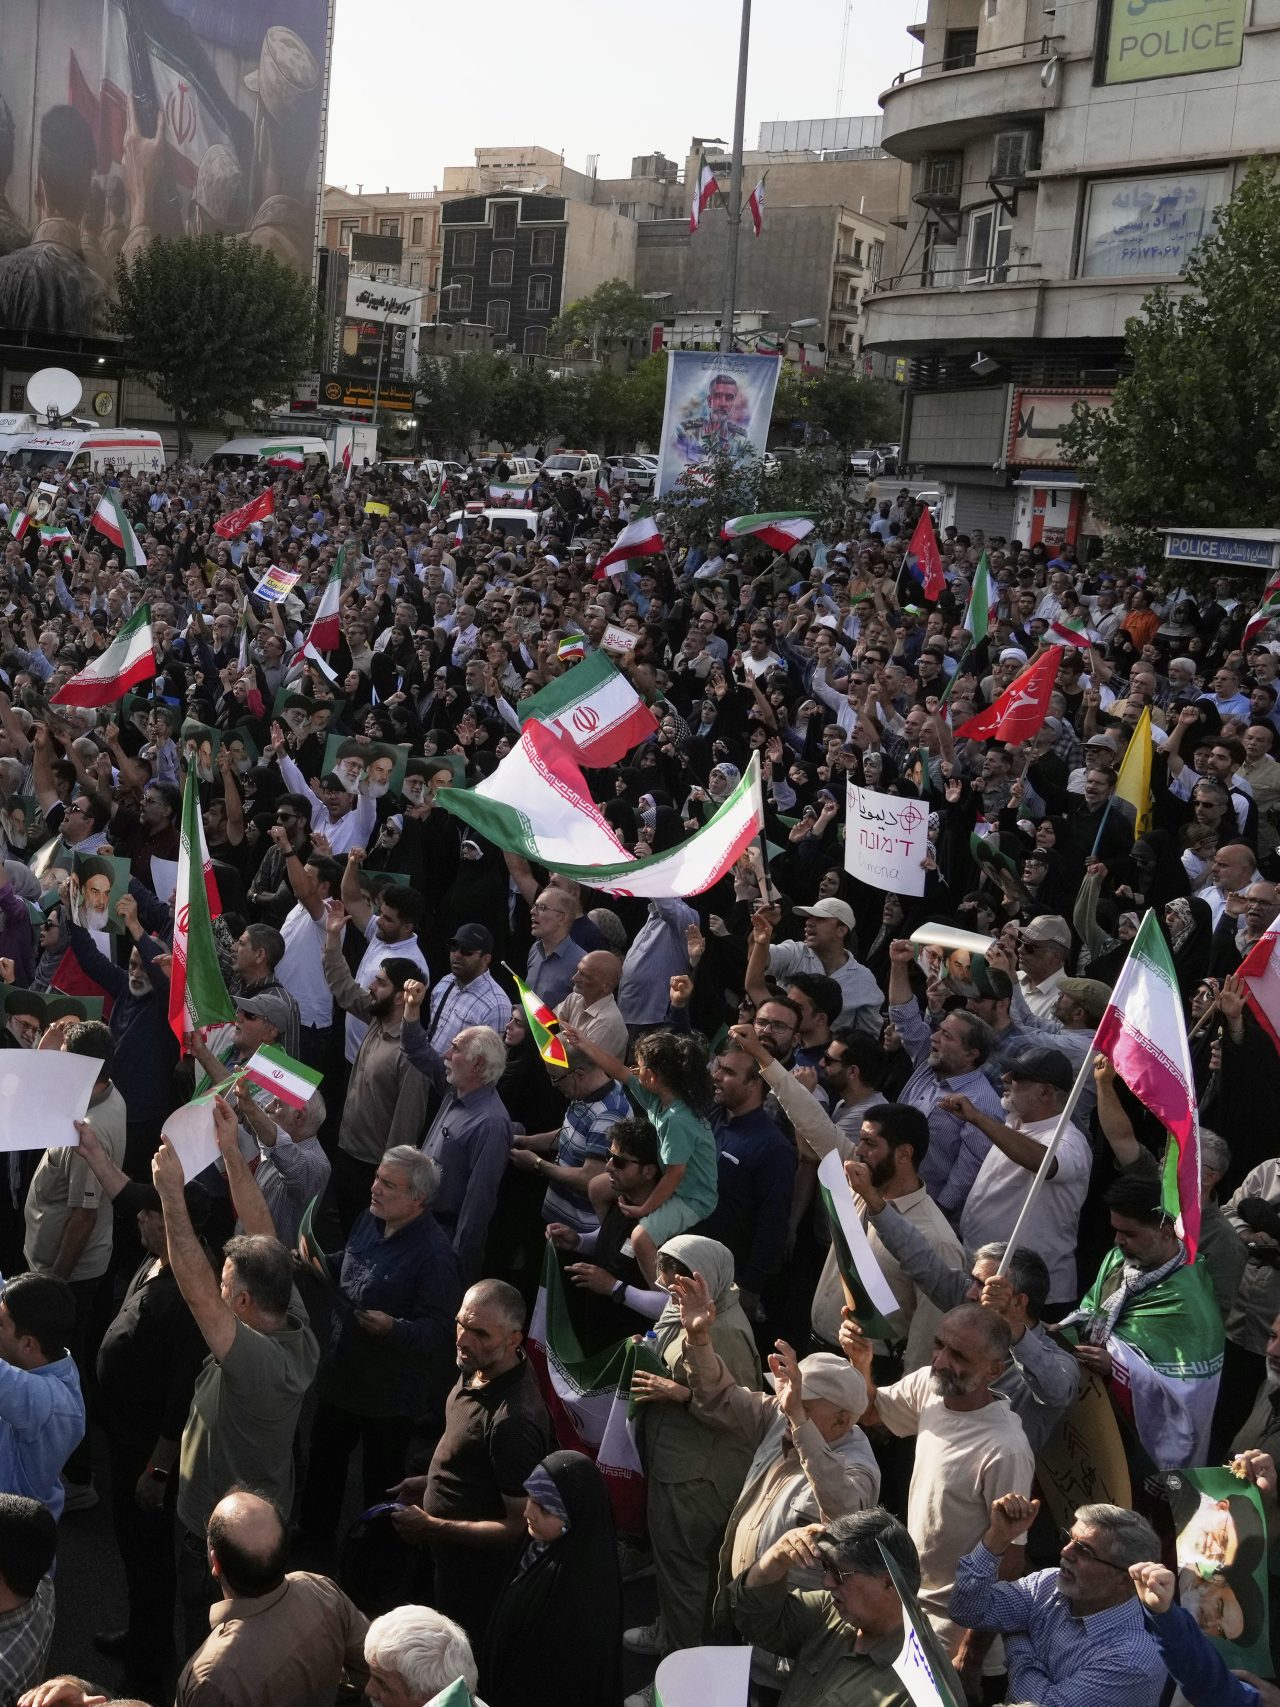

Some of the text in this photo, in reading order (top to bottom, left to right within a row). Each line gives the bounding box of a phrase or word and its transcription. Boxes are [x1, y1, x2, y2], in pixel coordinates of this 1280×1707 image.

[1119, 20, 1235, 61] POLICE
[1112, 181, 1197, 213] دفترخانه
[1153, 212, 1187, 229] اسناد
[332, 316, 342, 374] SAMSUNG
[104, 457, 115, 465] EMS
[1171, 538, 1219, 557] POLICE
[858, 788, 897, 831] دیمونا
[861, 829, 914, 857] דימונה
